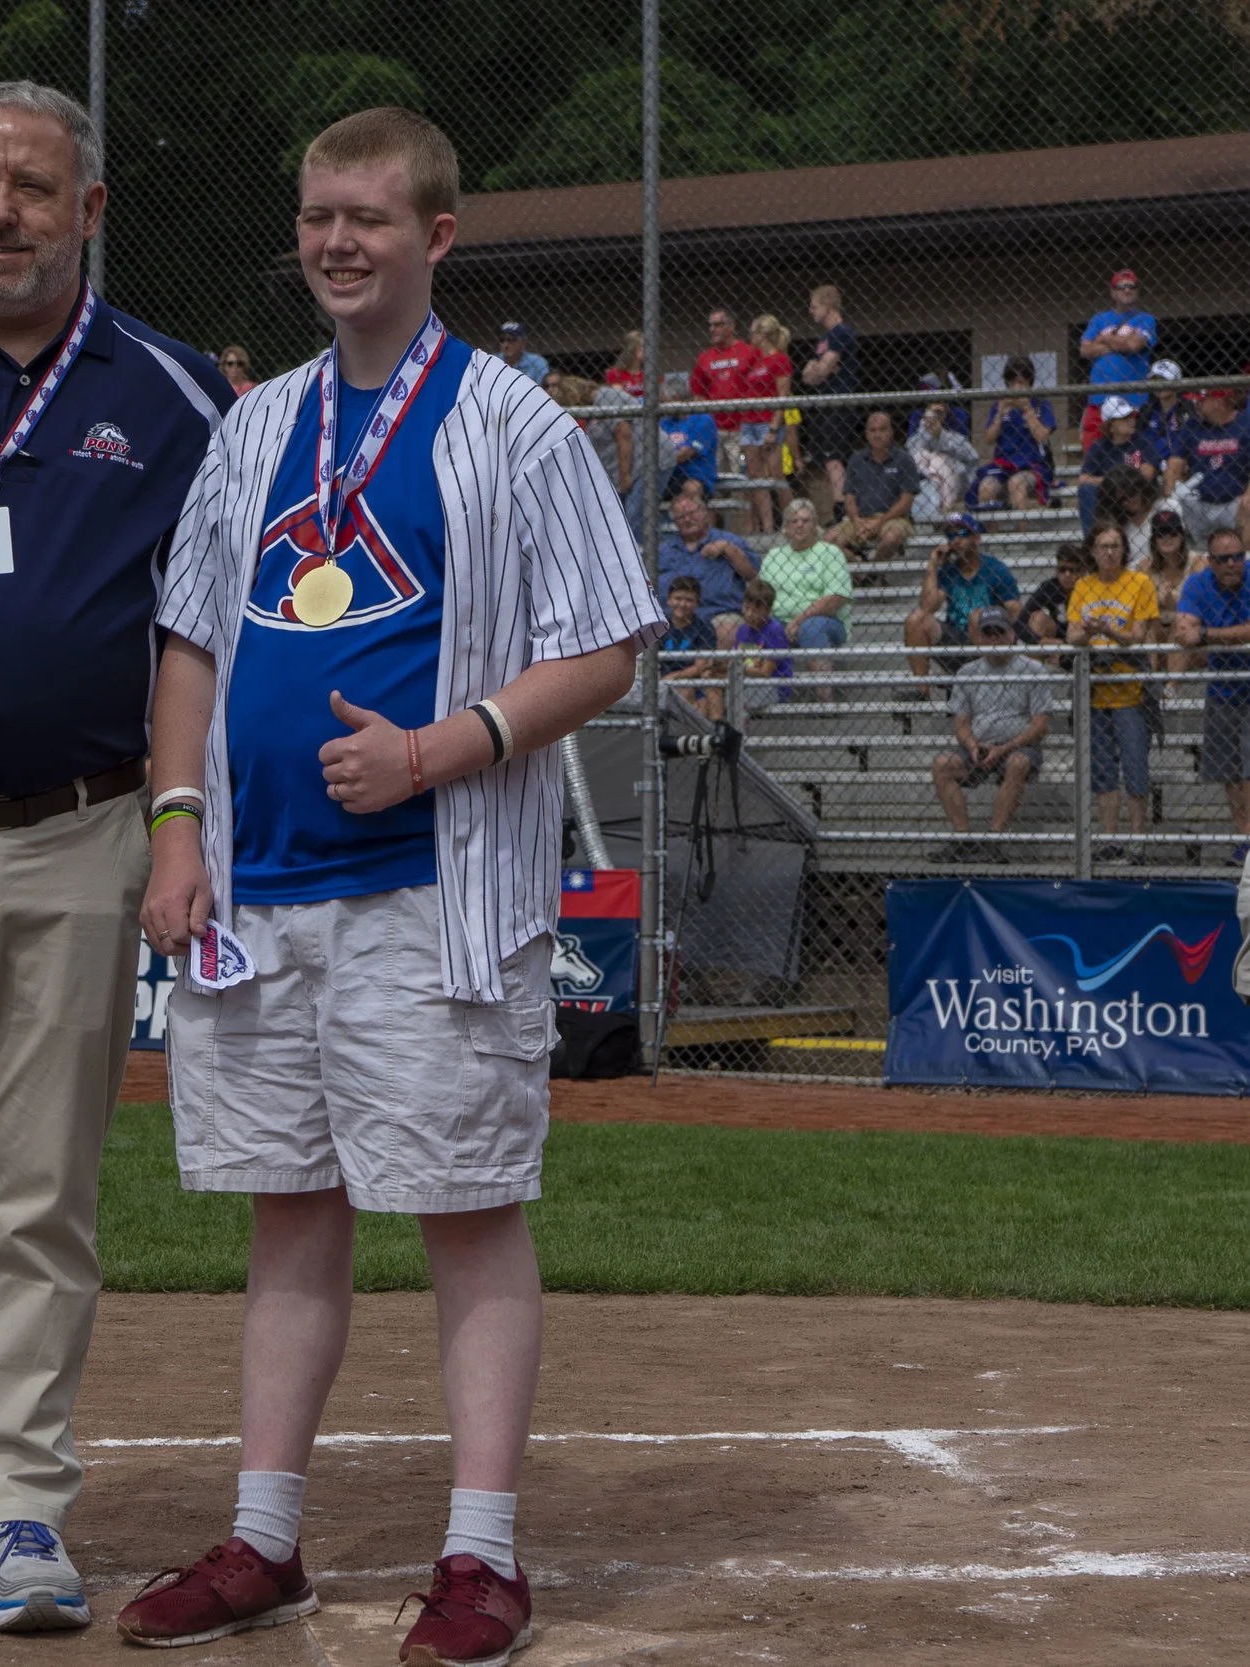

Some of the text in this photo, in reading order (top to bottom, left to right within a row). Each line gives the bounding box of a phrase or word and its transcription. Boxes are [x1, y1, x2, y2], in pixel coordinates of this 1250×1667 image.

[84, 437, 130, 455] PONY
[982, 963, 1034, 985] visit
[926, 978, 1209, 1049] Washington
[1066, 1036, 1102, 1056] PA
